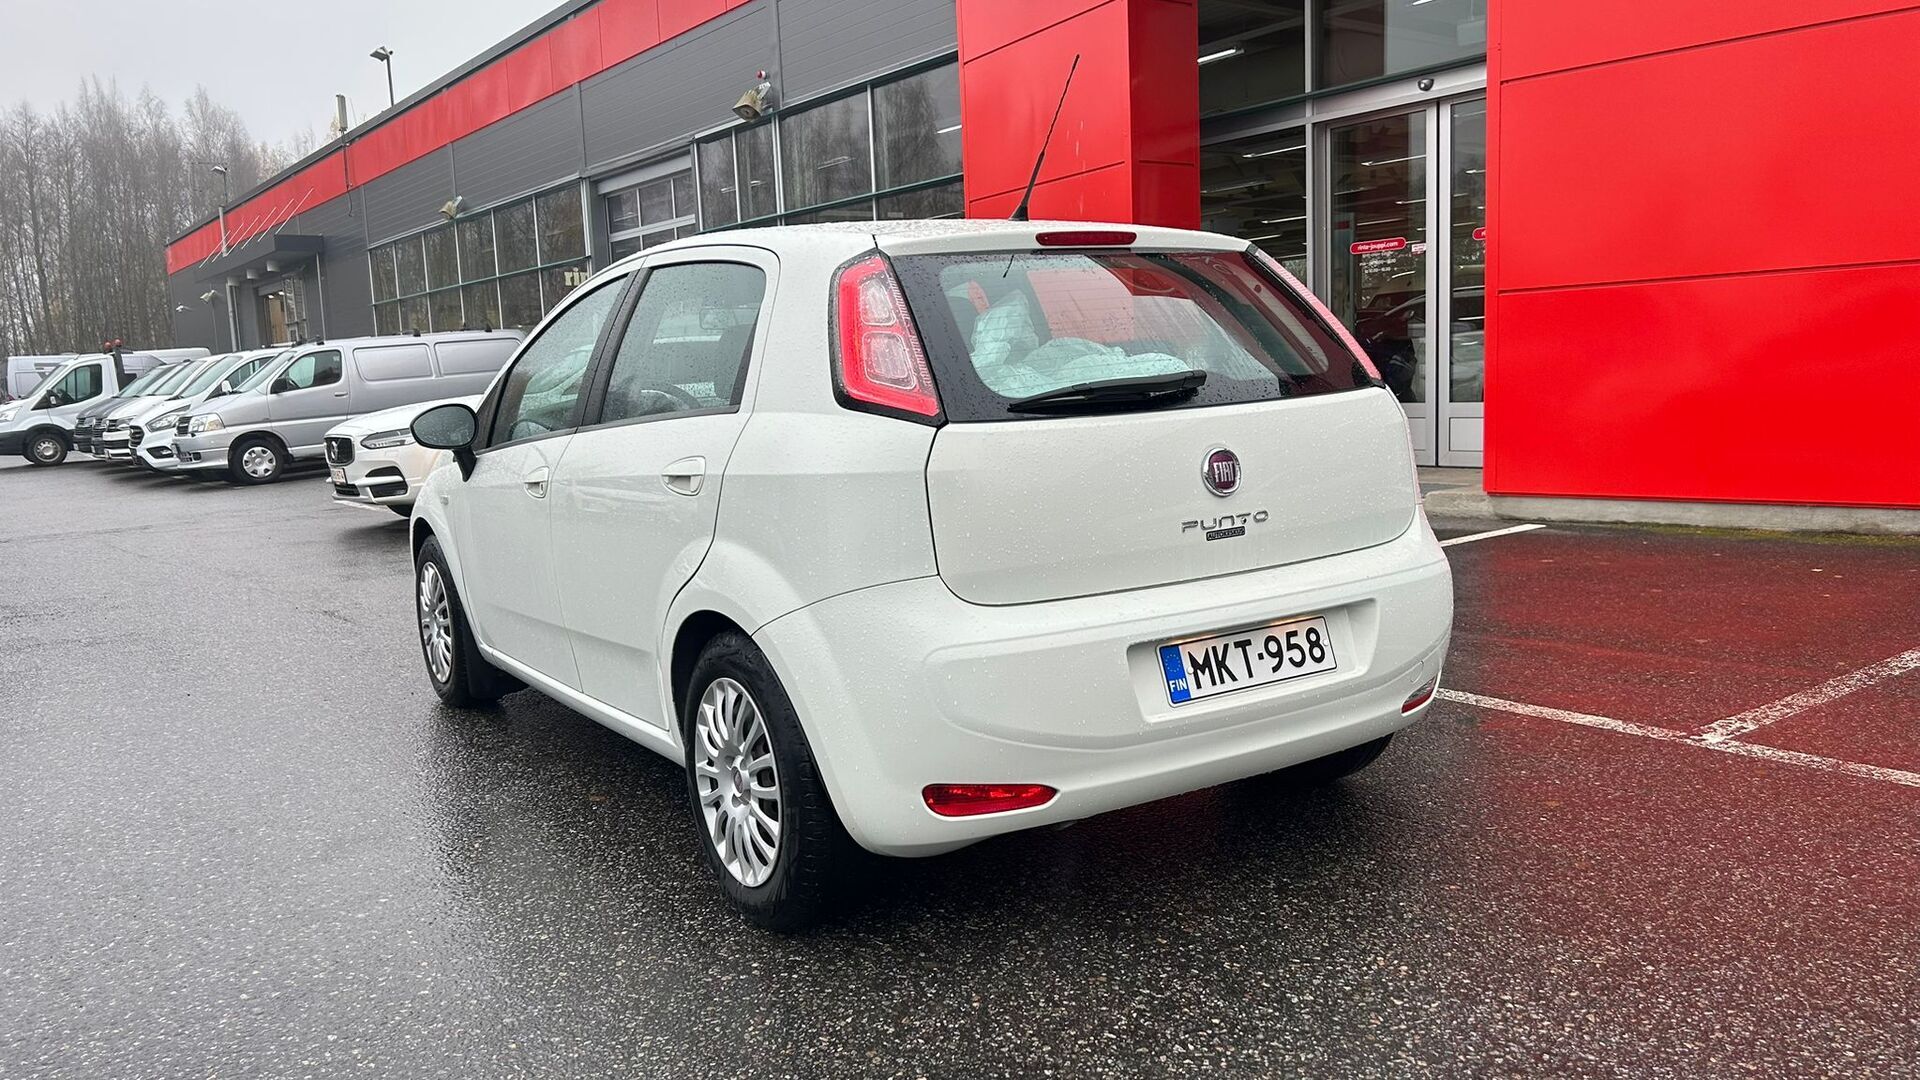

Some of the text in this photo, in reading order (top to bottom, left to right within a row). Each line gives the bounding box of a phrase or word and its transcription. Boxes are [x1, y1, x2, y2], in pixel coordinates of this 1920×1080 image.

[1213, 460, 1235, 483] FIAT
[1187, 626, 1326, 690] MKT-958
[1170, 677, 1188, 693] FIN
